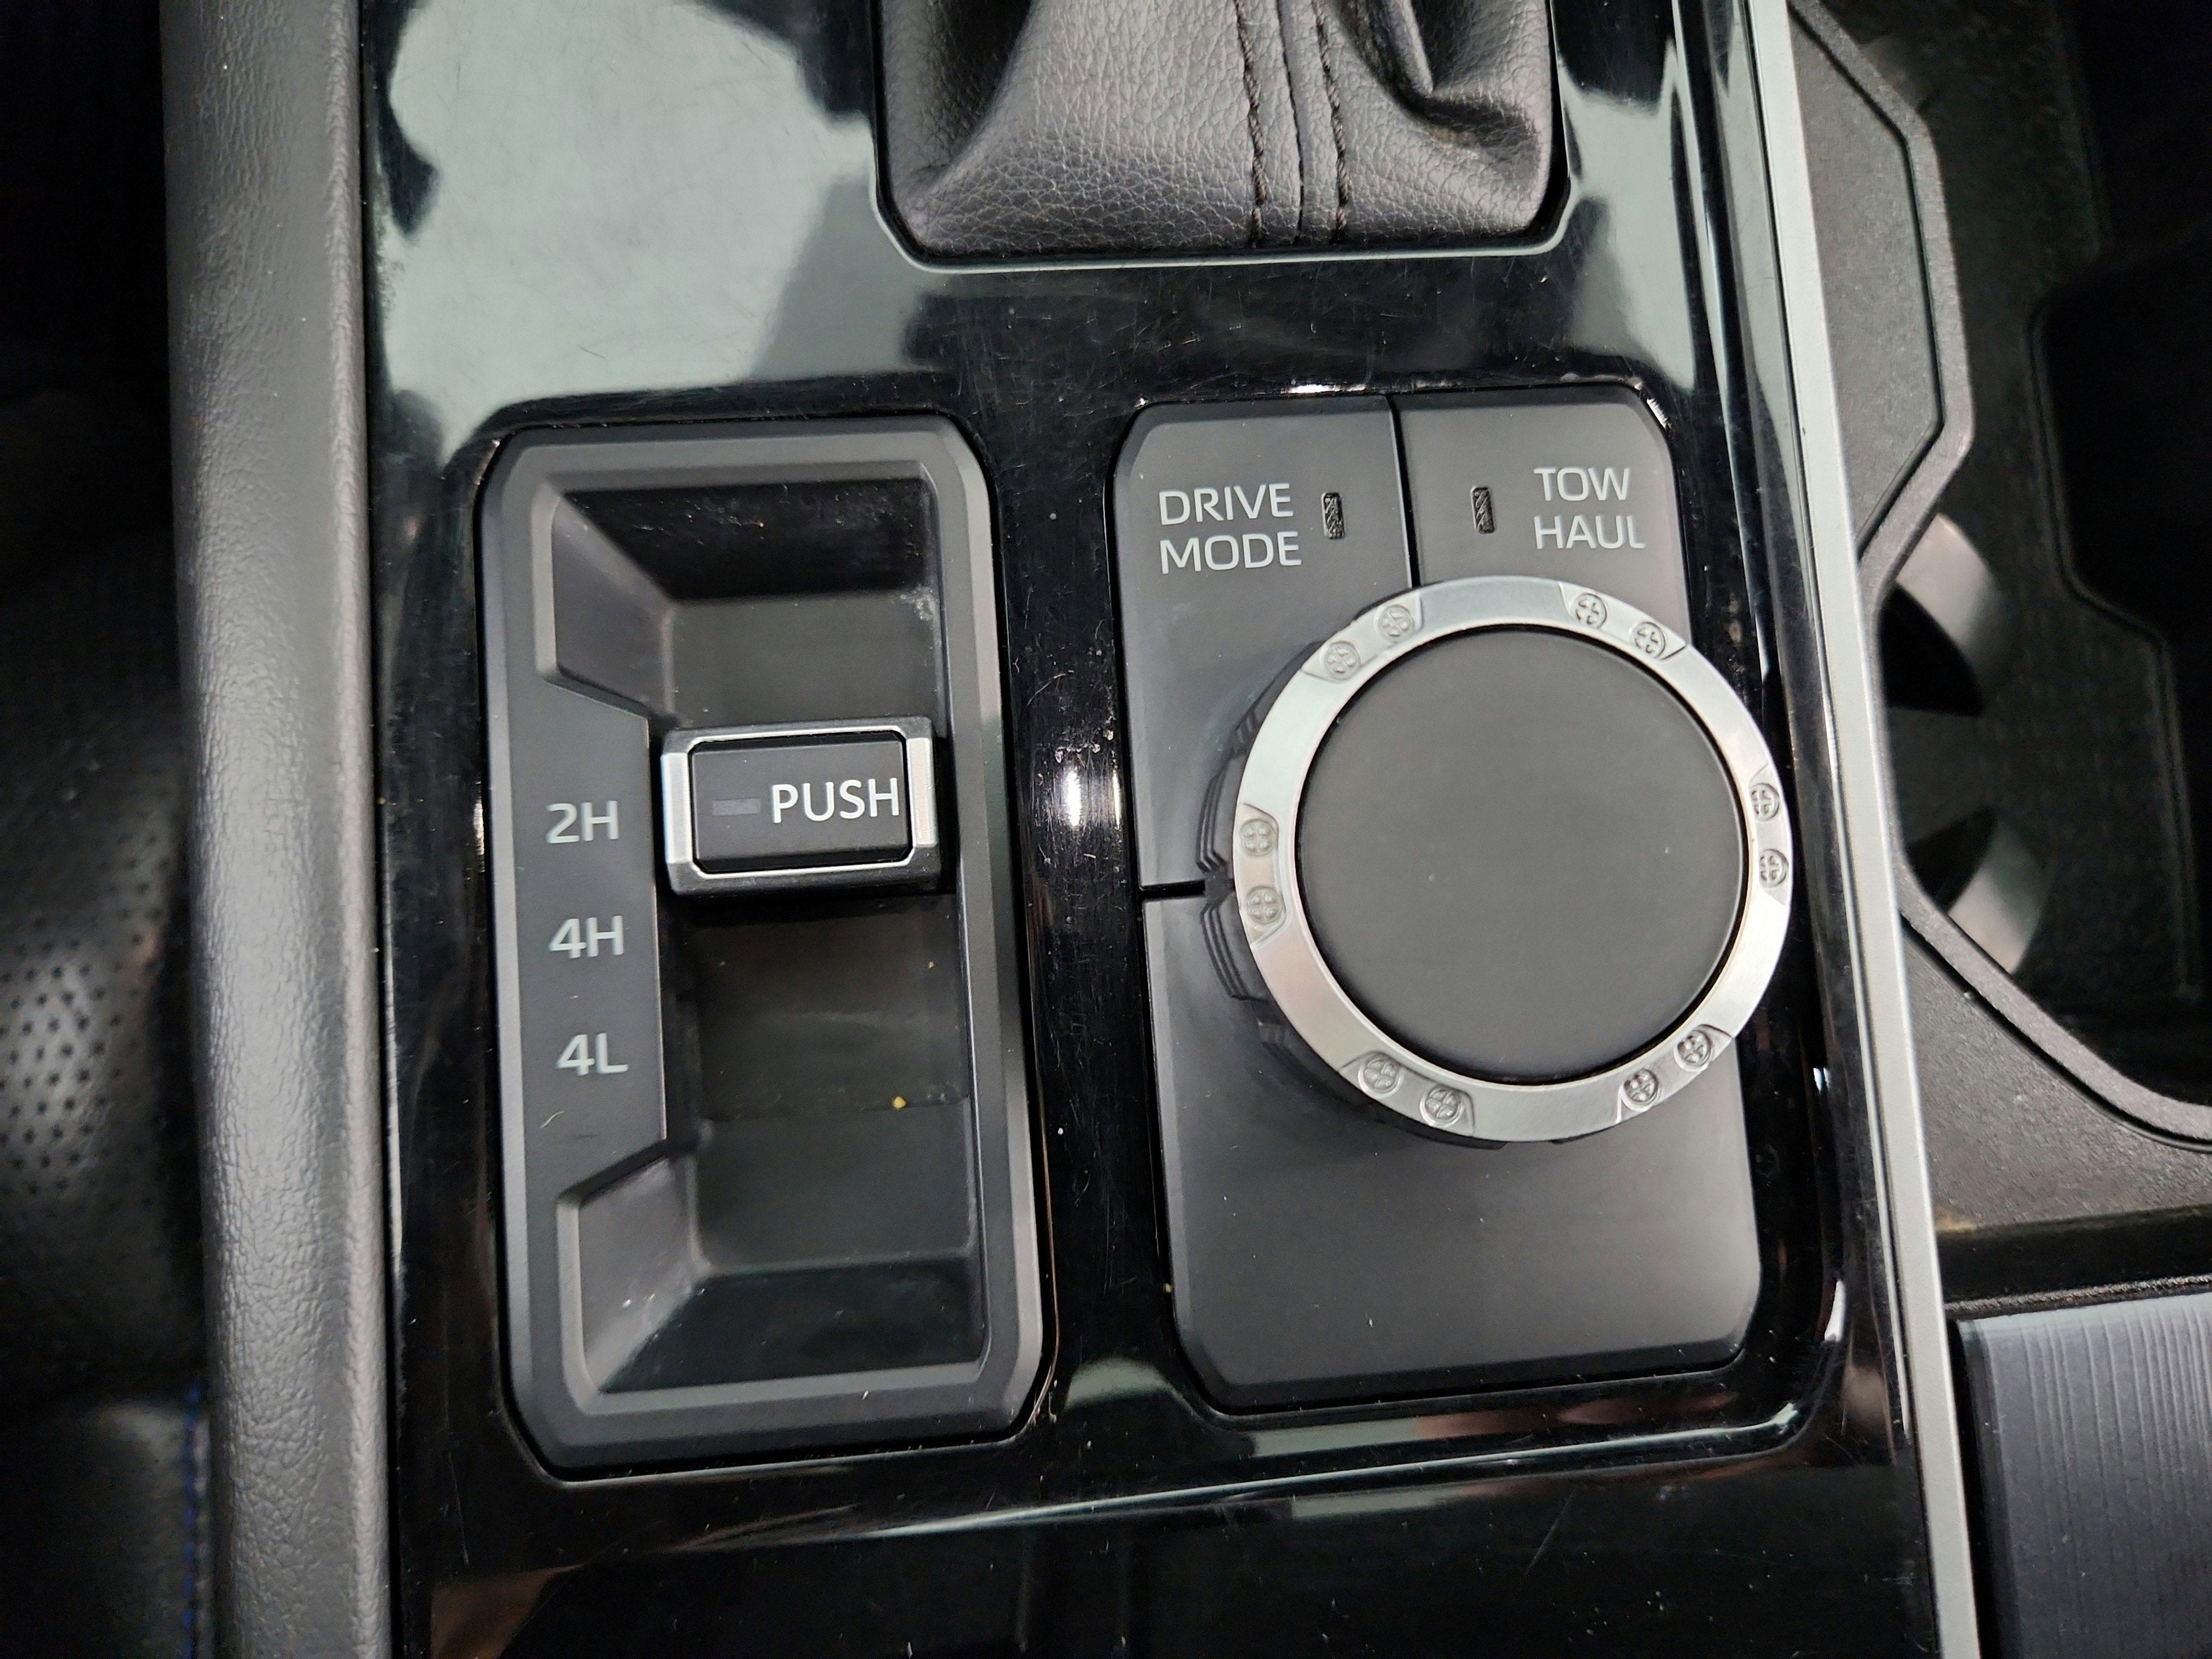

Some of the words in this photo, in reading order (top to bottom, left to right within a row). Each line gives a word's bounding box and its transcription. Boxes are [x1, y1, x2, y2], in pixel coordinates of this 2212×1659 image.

[1159, 483, 1294, 526] DRIVE
[1533, 467, 1630, 501] TOW
[1159, 531, 1302, 574] MODE
[1533, 515, 1646, 550] HAUL
[548, 800, 618, 844] 2H
[771, 777, 900, 824] PUSH
[550, 915, 624, 959] 4H
[557, 1032, 629, 1076] 4L
